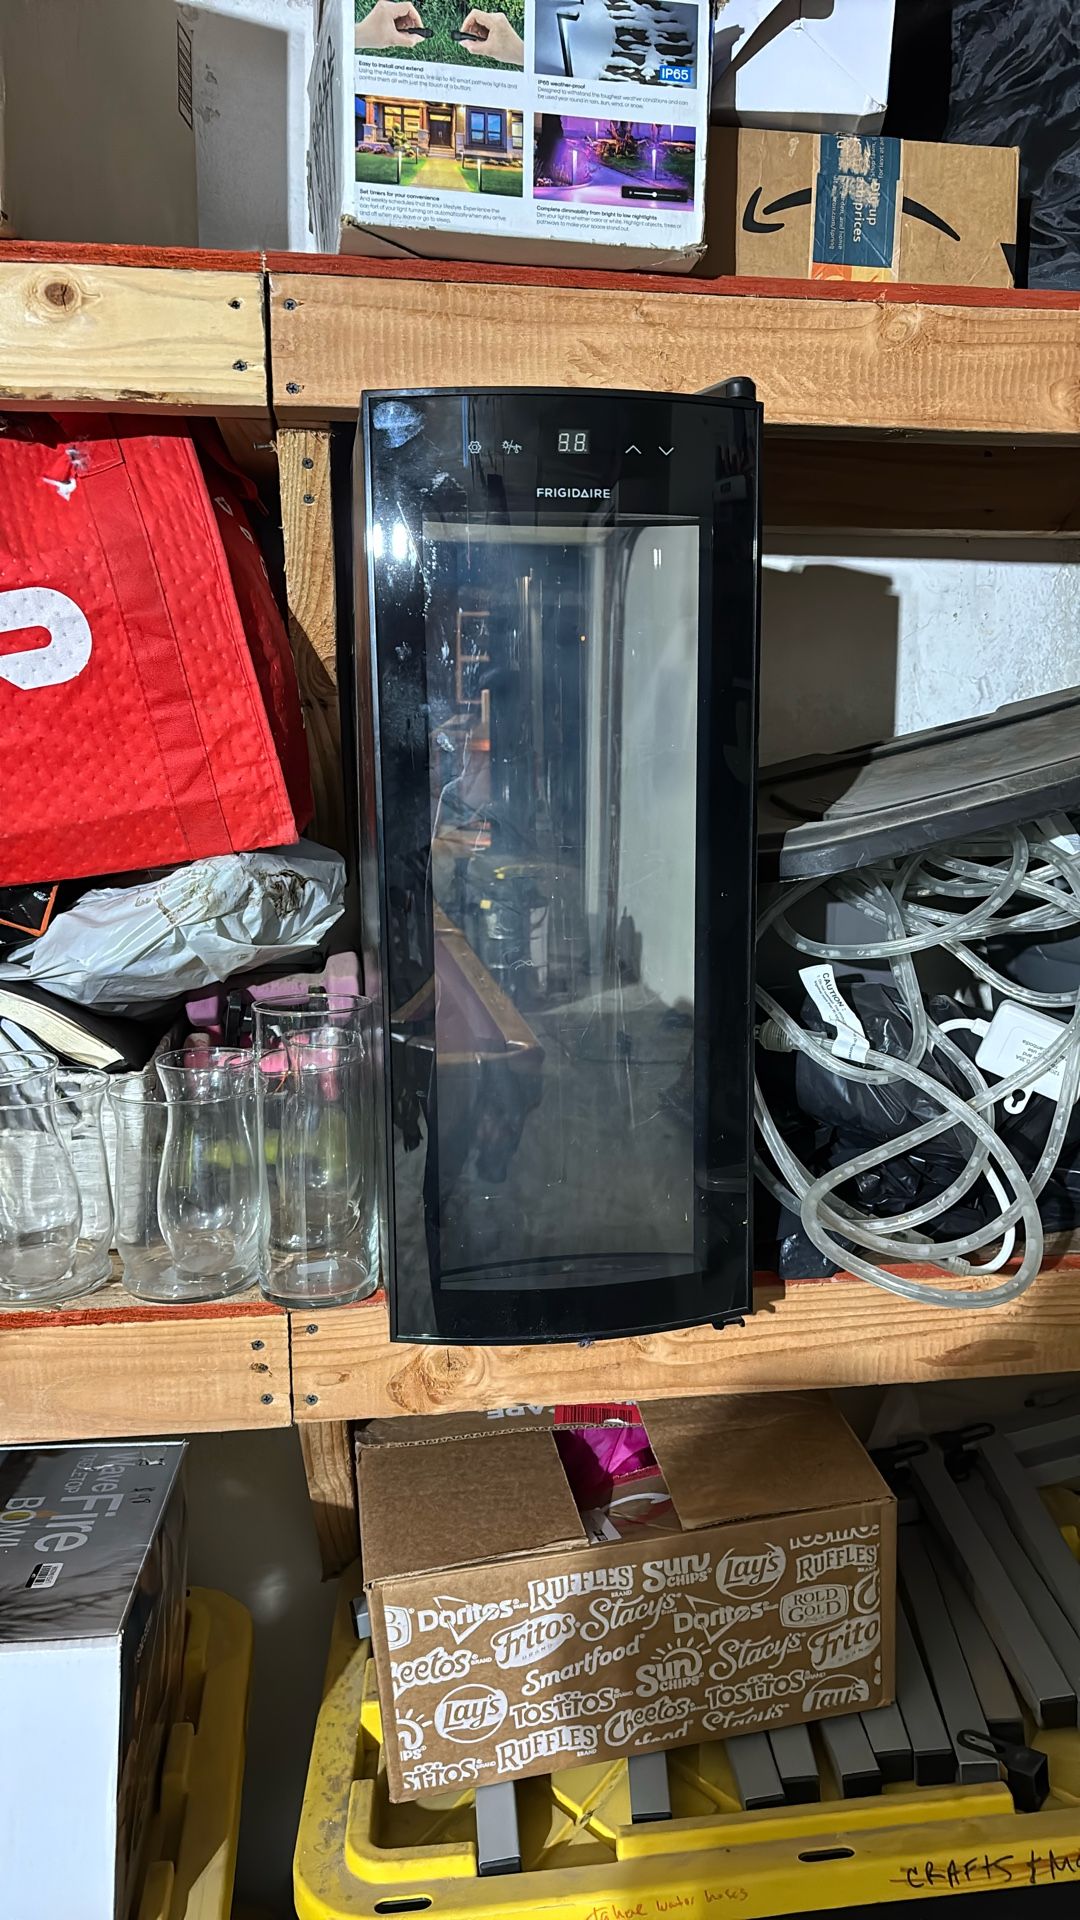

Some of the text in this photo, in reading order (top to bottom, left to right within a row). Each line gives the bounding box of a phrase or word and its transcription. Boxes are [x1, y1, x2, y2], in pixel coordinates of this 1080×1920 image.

[661, 67, 689, 80] IP65
[852, 202, 865, 243] prices
[866, 208, 878, 226] up
[536, 487, 611, 499] FRIGIDAIRE
[91, 1452, 139, 1493] Wave
[34, 1493, 125, 1552] Fire
[666, 1571, 709, 1588] CHIPS
[795, 1544, 878, 1584] RUFFLES
[528, 1565, 634, 1613] RUFFLES
[793, 1588, 839, 1606] ROLD
[417, 1599, 514, 1635] Doritos
[580, 1593, 677, 1642] Stacy's
[673, 1601, 764, 1634] Doritos
[788, 1600, 842, 1623] GOLD
[491, 1614, 575, 1667] Fritos
[708, 1632, 801, 1681] Stacy's
[391, 1648, 472, 1688] eetos
[521, 1635, 641, 1696] Smartfood
[659, 1676, 700, 1692] CHIPS
[510, 1688, 616, 1729] TOSTITOS
[705, 1669, 806, 1710] TOSTITOS
[442, 1694, 502, 1730] Lay's
[604, 1696, 691, 1746] Cheetos
[495, 1725, 598, 1774] RUFFLES
